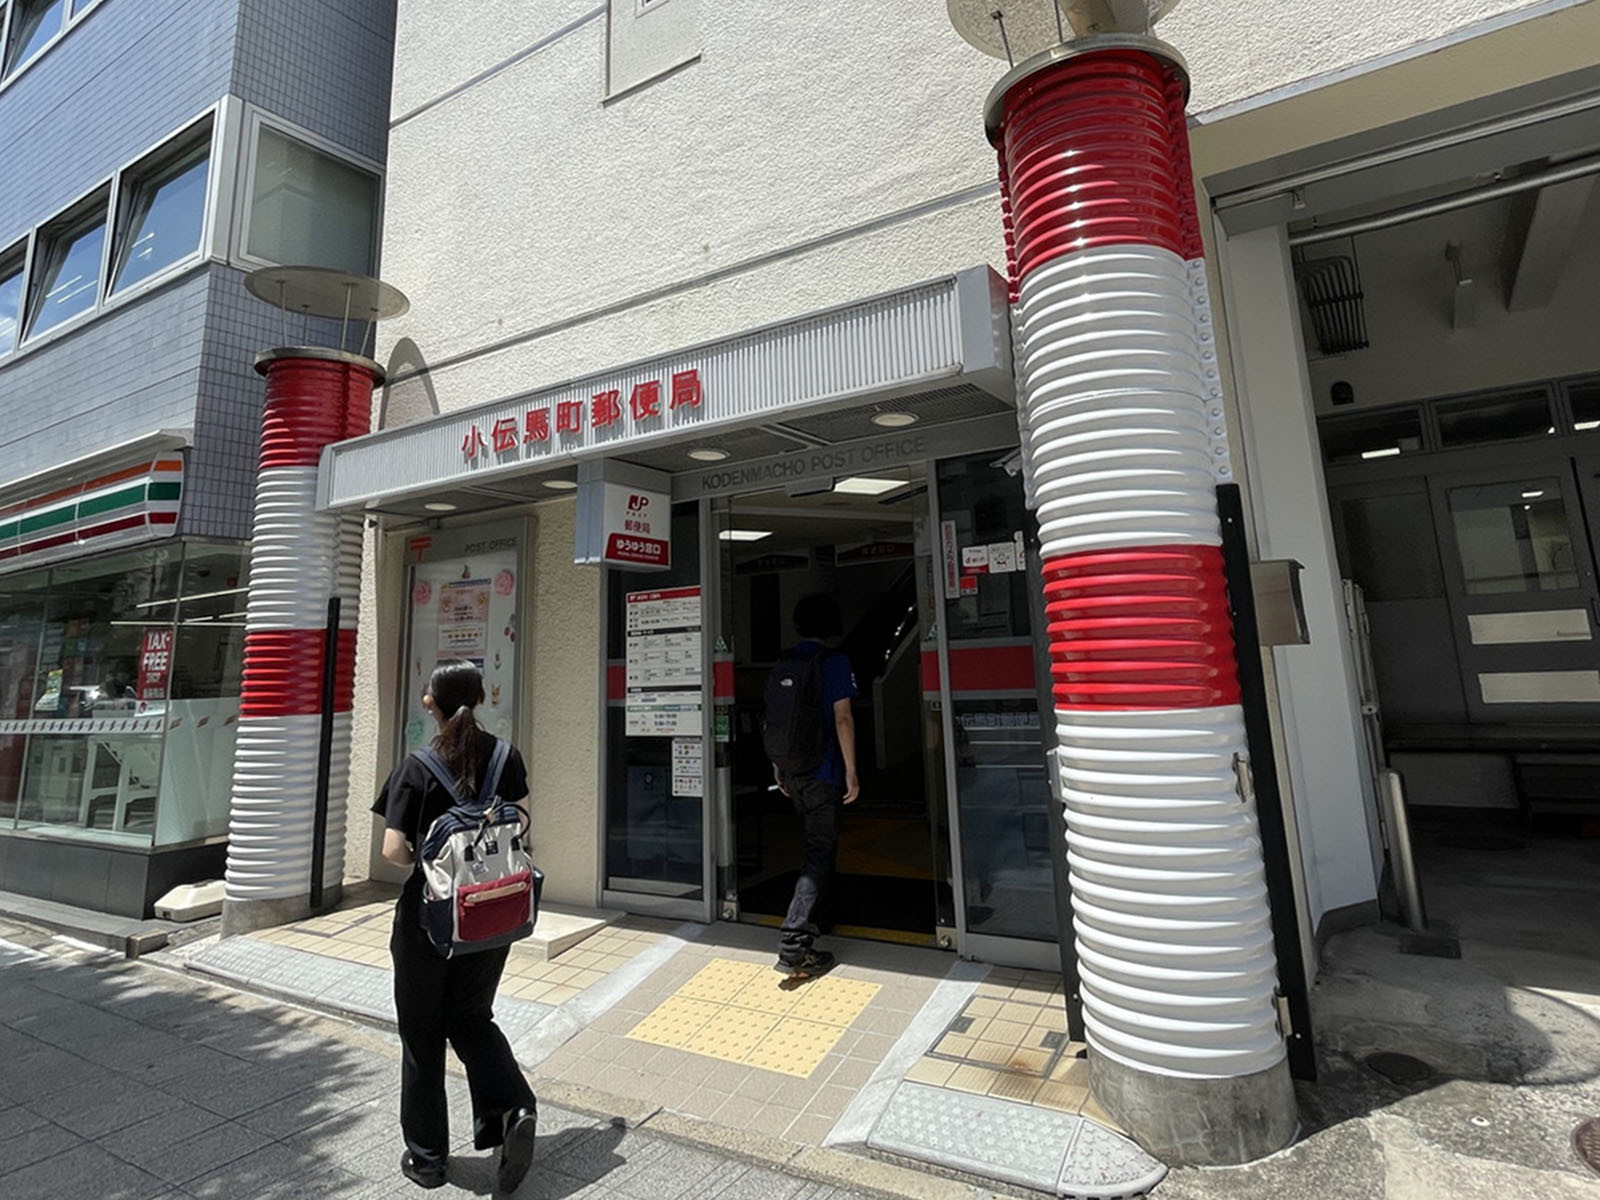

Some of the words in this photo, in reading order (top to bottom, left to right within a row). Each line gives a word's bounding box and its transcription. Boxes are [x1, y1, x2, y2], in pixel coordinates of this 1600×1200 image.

[461, 369, 702, 458] 小伝馬町郵便局
[702, 459, 806, 491] KODENMACHO
[811, 451, 855, 472] POST
[862, 436, 926, 463] OFFICE
[625, 519, 651, 534] 郵便局
[465, 541, 486, 553] POST
[488, 536, 518, 551] OFFICE
[616, 539, 661, 555] ゆうゆう窓口
[142, 652, 169, 671] FREE
